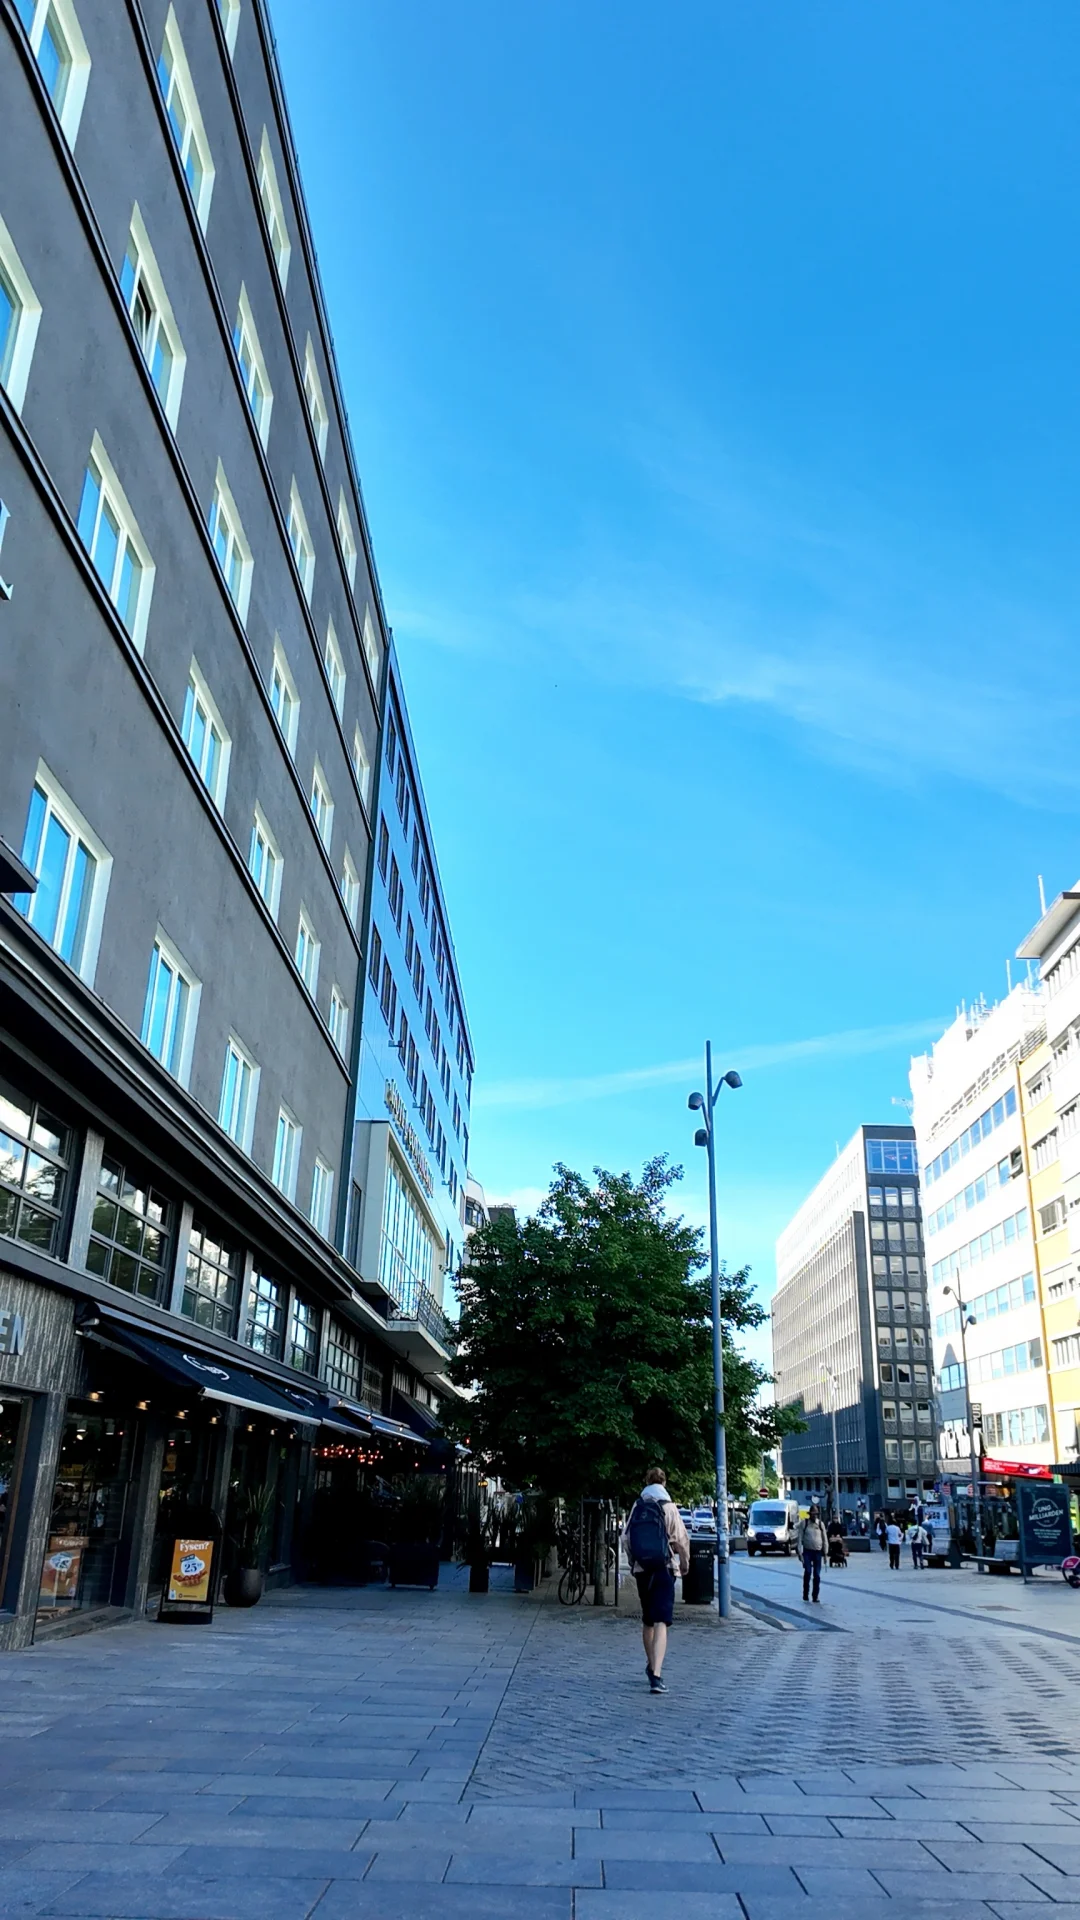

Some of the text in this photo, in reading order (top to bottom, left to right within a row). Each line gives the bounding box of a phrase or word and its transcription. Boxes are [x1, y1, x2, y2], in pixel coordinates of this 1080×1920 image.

[972, 1403, 982, 1424] PUB
[1037, 1504, 1051, 1513] UNG
[1029, 1509, 1064, 1521] MILLIARDEN
[180, 1542, 209, 1552] Fysen?
